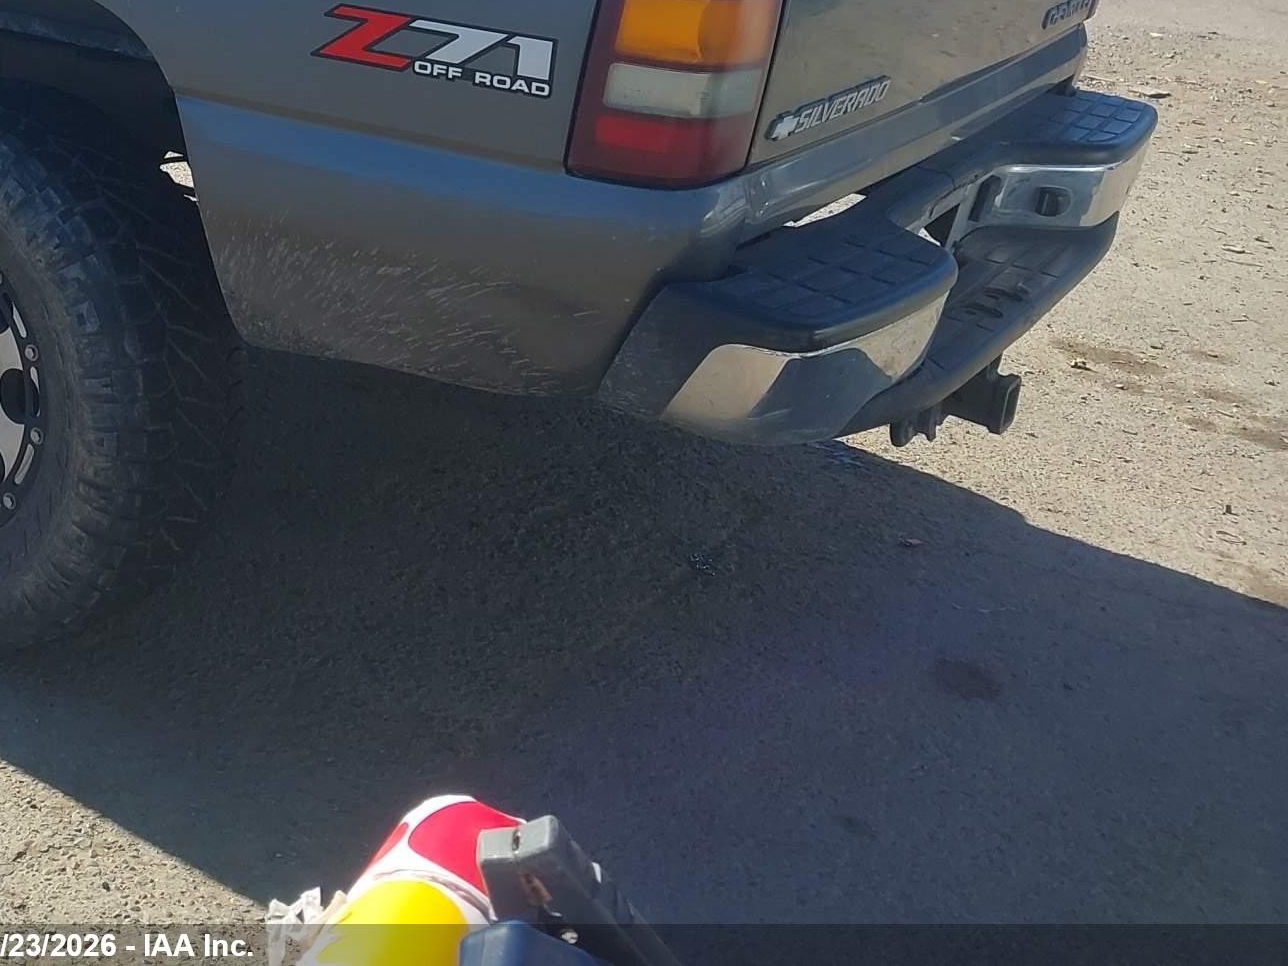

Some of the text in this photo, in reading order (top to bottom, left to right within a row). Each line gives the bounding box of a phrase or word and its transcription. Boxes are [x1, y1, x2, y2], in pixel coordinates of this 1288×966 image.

[311, 3, 557, 83] Z71
[414, 60, 551, 97] OFF ROAD
[794, 79, 891, 134] SILVERADO
